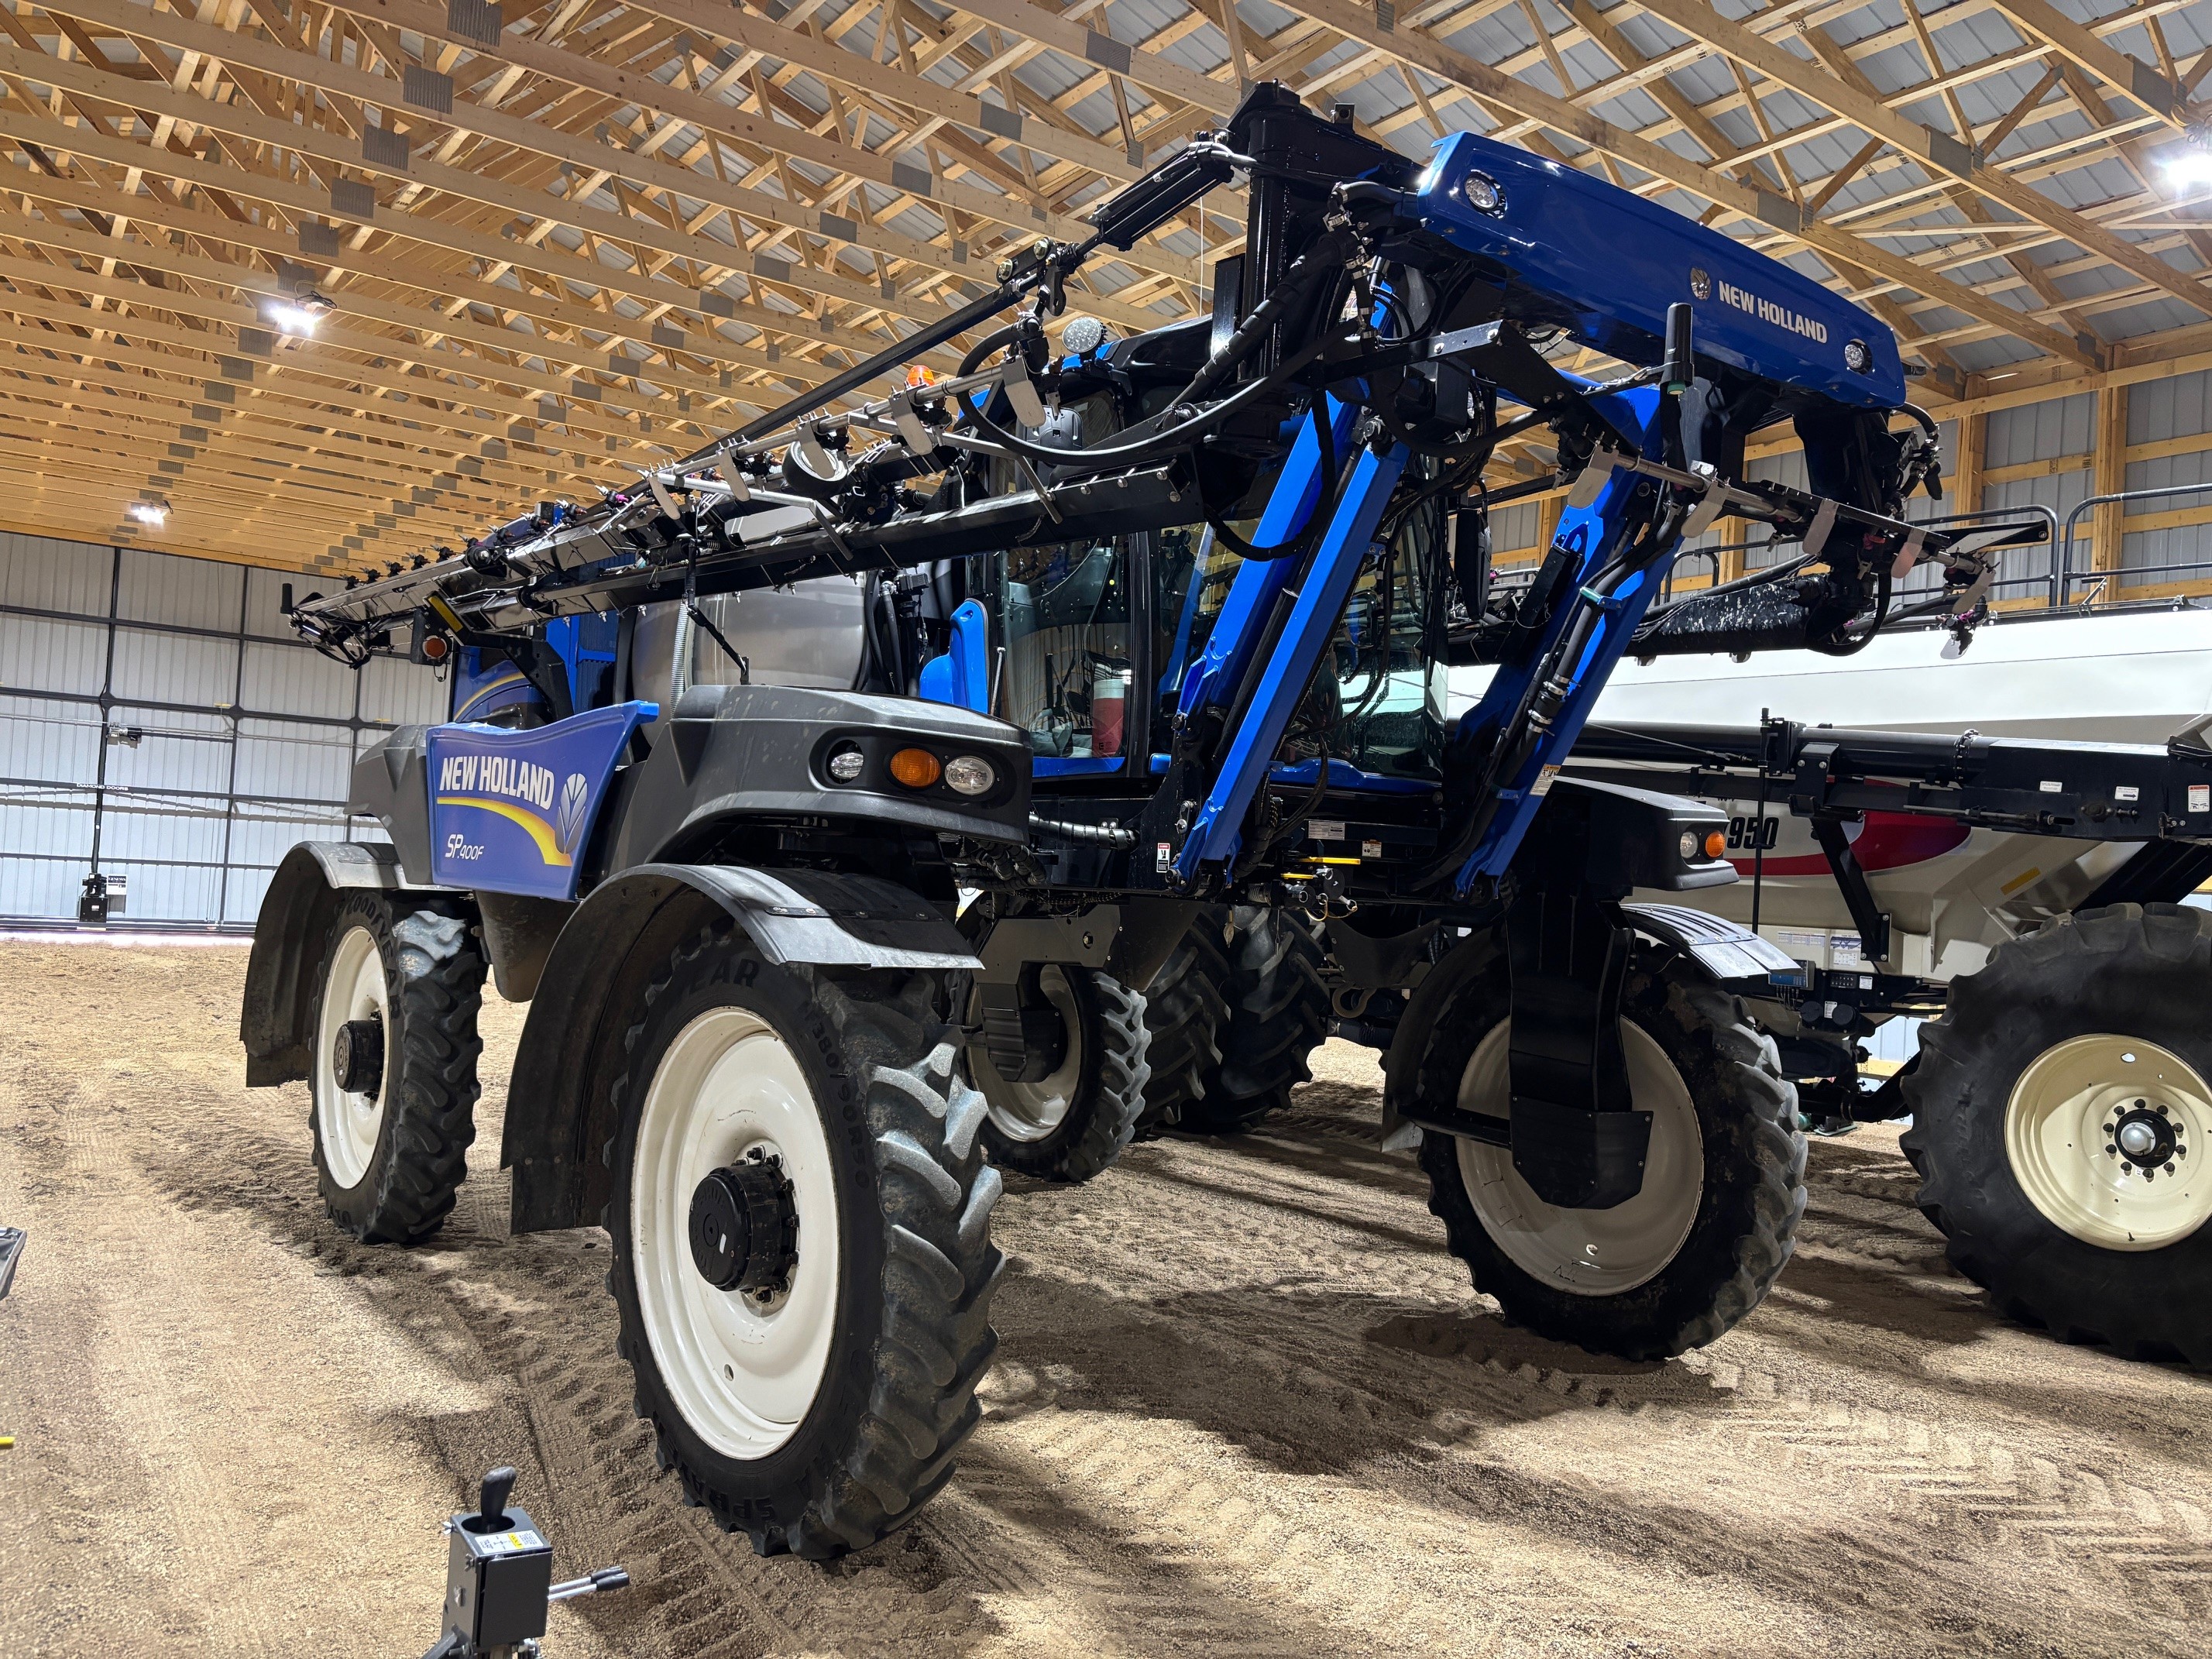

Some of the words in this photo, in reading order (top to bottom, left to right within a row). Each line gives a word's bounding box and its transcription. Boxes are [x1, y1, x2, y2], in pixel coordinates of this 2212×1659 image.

[1719, 280, 1754, 314] NEW
[1757, 297, 1827, 344] HOLLAND
[440, 756, 478, 792] NEW
[479, 757, 555, 810] HOLLAND
[1724, 816, 1779, 850] 950
